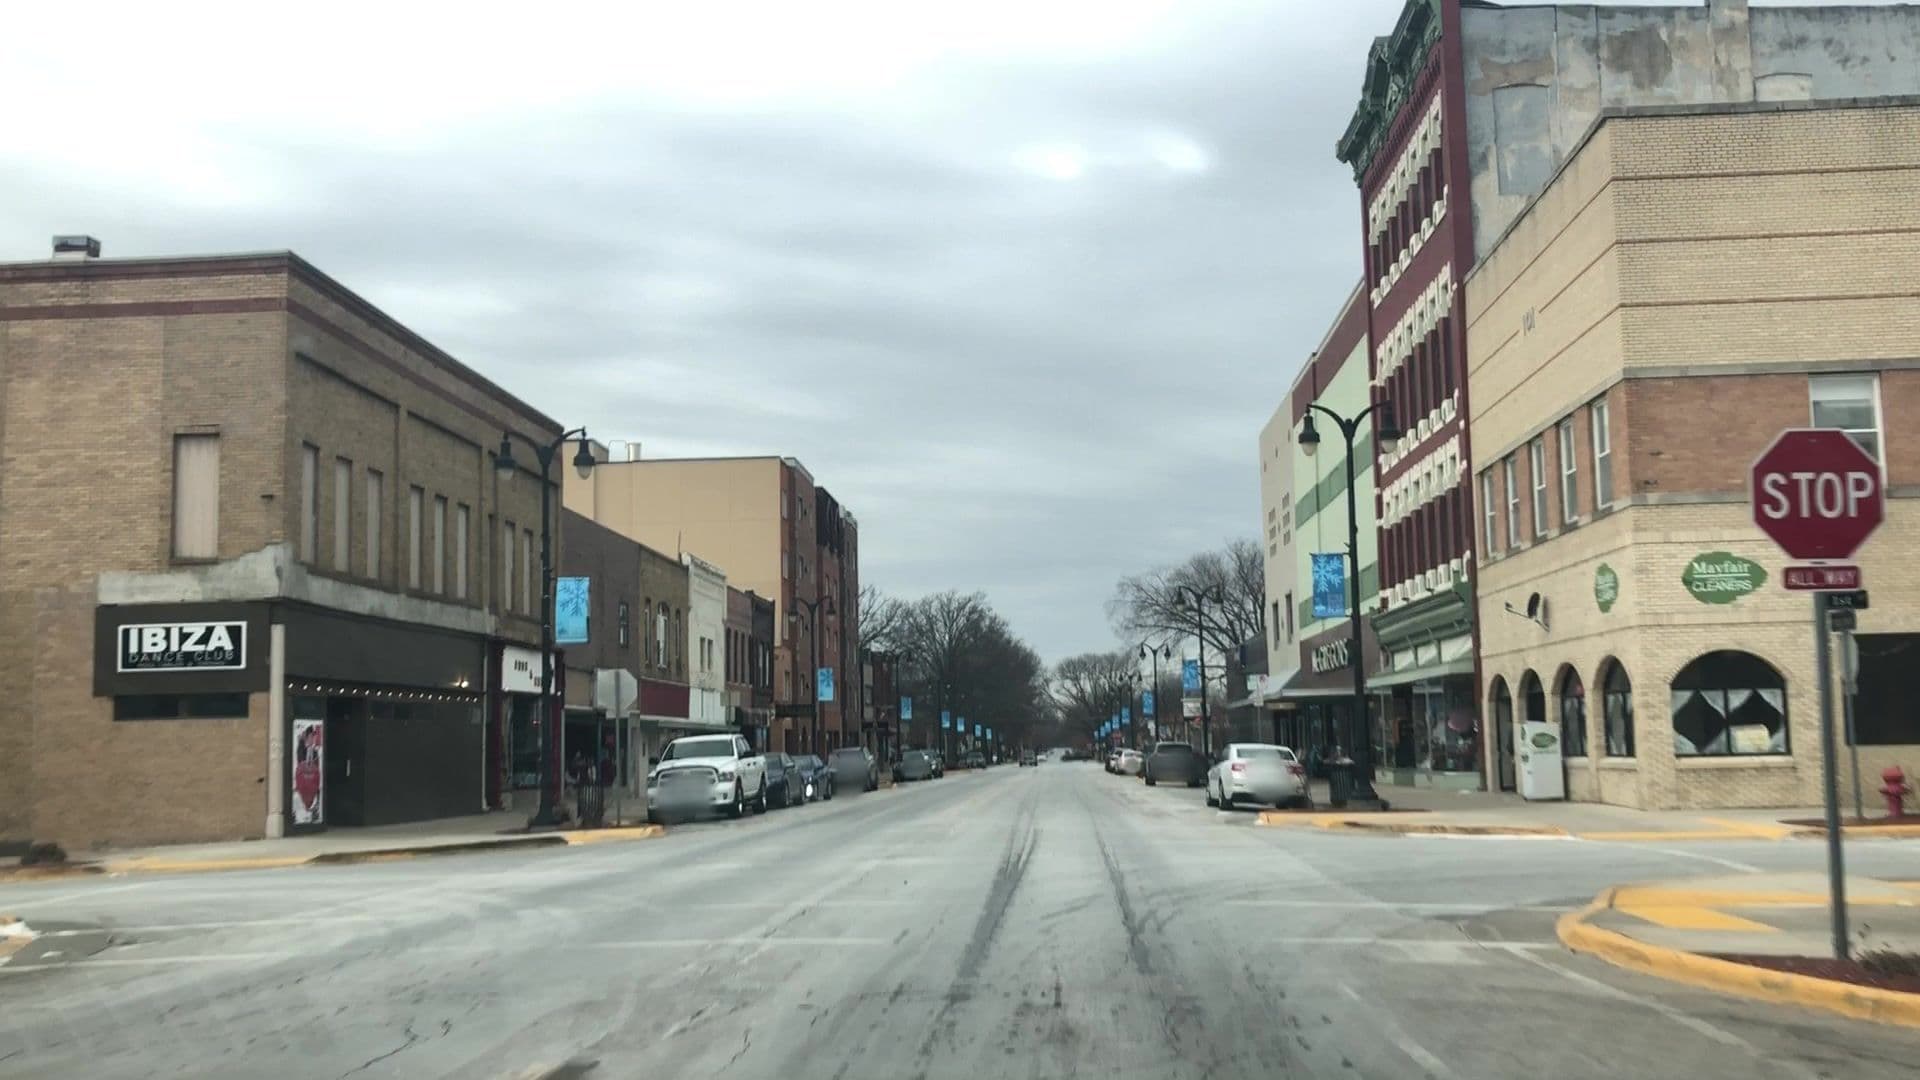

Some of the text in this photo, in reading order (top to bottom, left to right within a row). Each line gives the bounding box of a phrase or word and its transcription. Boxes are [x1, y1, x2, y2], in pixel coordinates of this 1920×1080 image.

[1761, 471, 1875, 519] STOP
[1692, 560, 1751, 574] Mayfair
[1692, 579, 1752, 592] CLEANERS
[128, 625, 234, 652] IBIZA
[128, 649, 234, 663] DANCE CLUB
